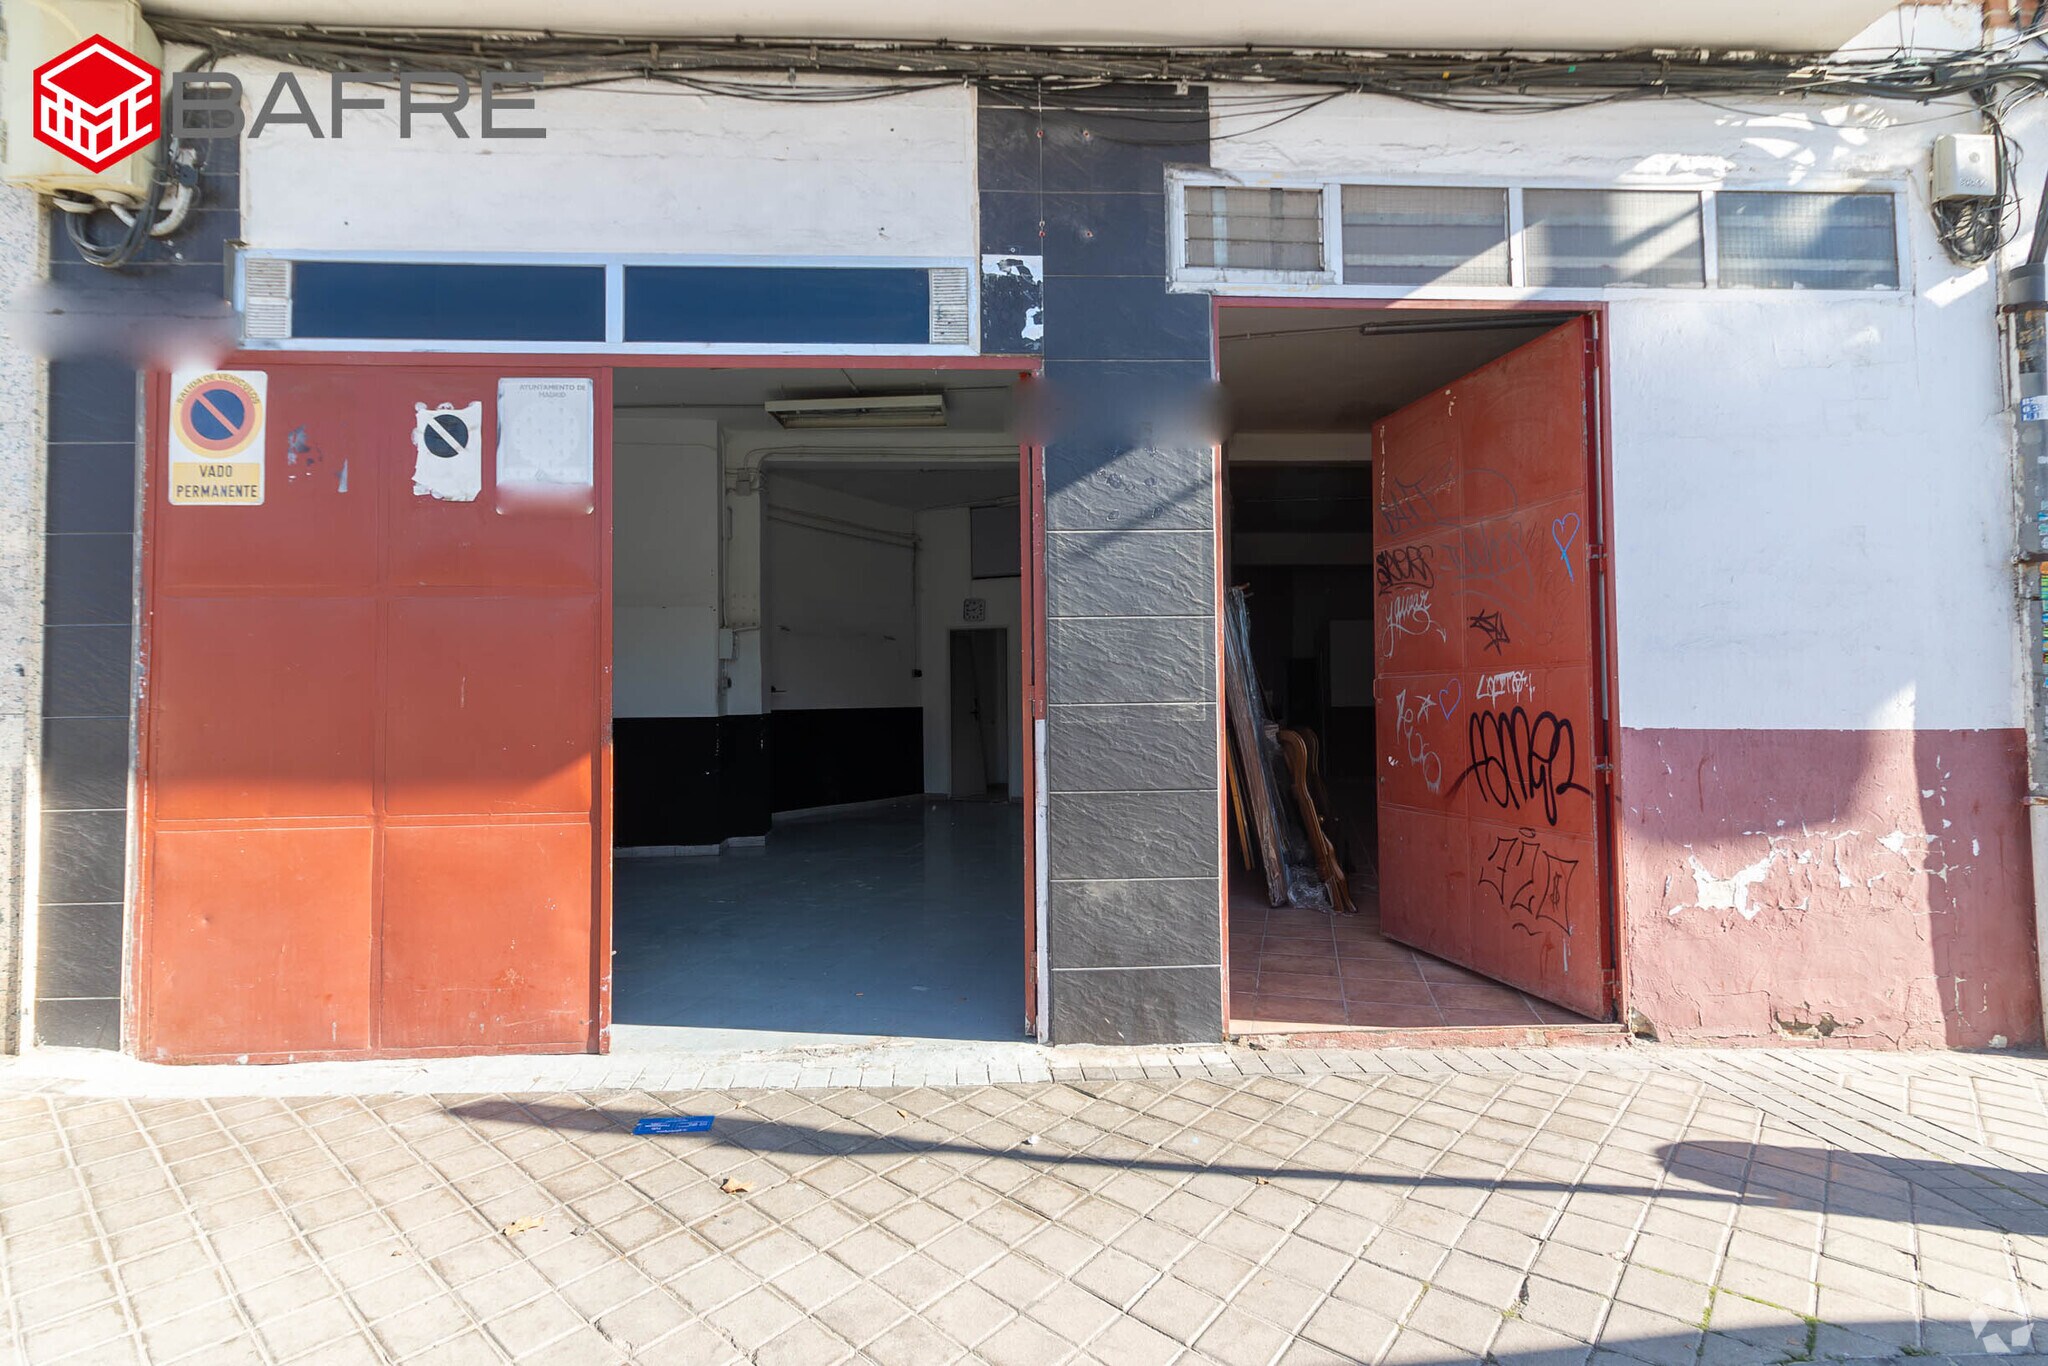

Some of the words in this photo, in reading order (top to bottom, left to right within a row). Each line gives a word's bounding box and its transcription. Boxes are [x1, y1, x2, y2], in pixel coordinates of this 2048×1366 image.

[177, 378, 203, 404] SALIDA
[204, 374, 214, 382] DE
[200, 465, 233, 477] VADO
[176, 485, 258, 497] PERMANENTE
